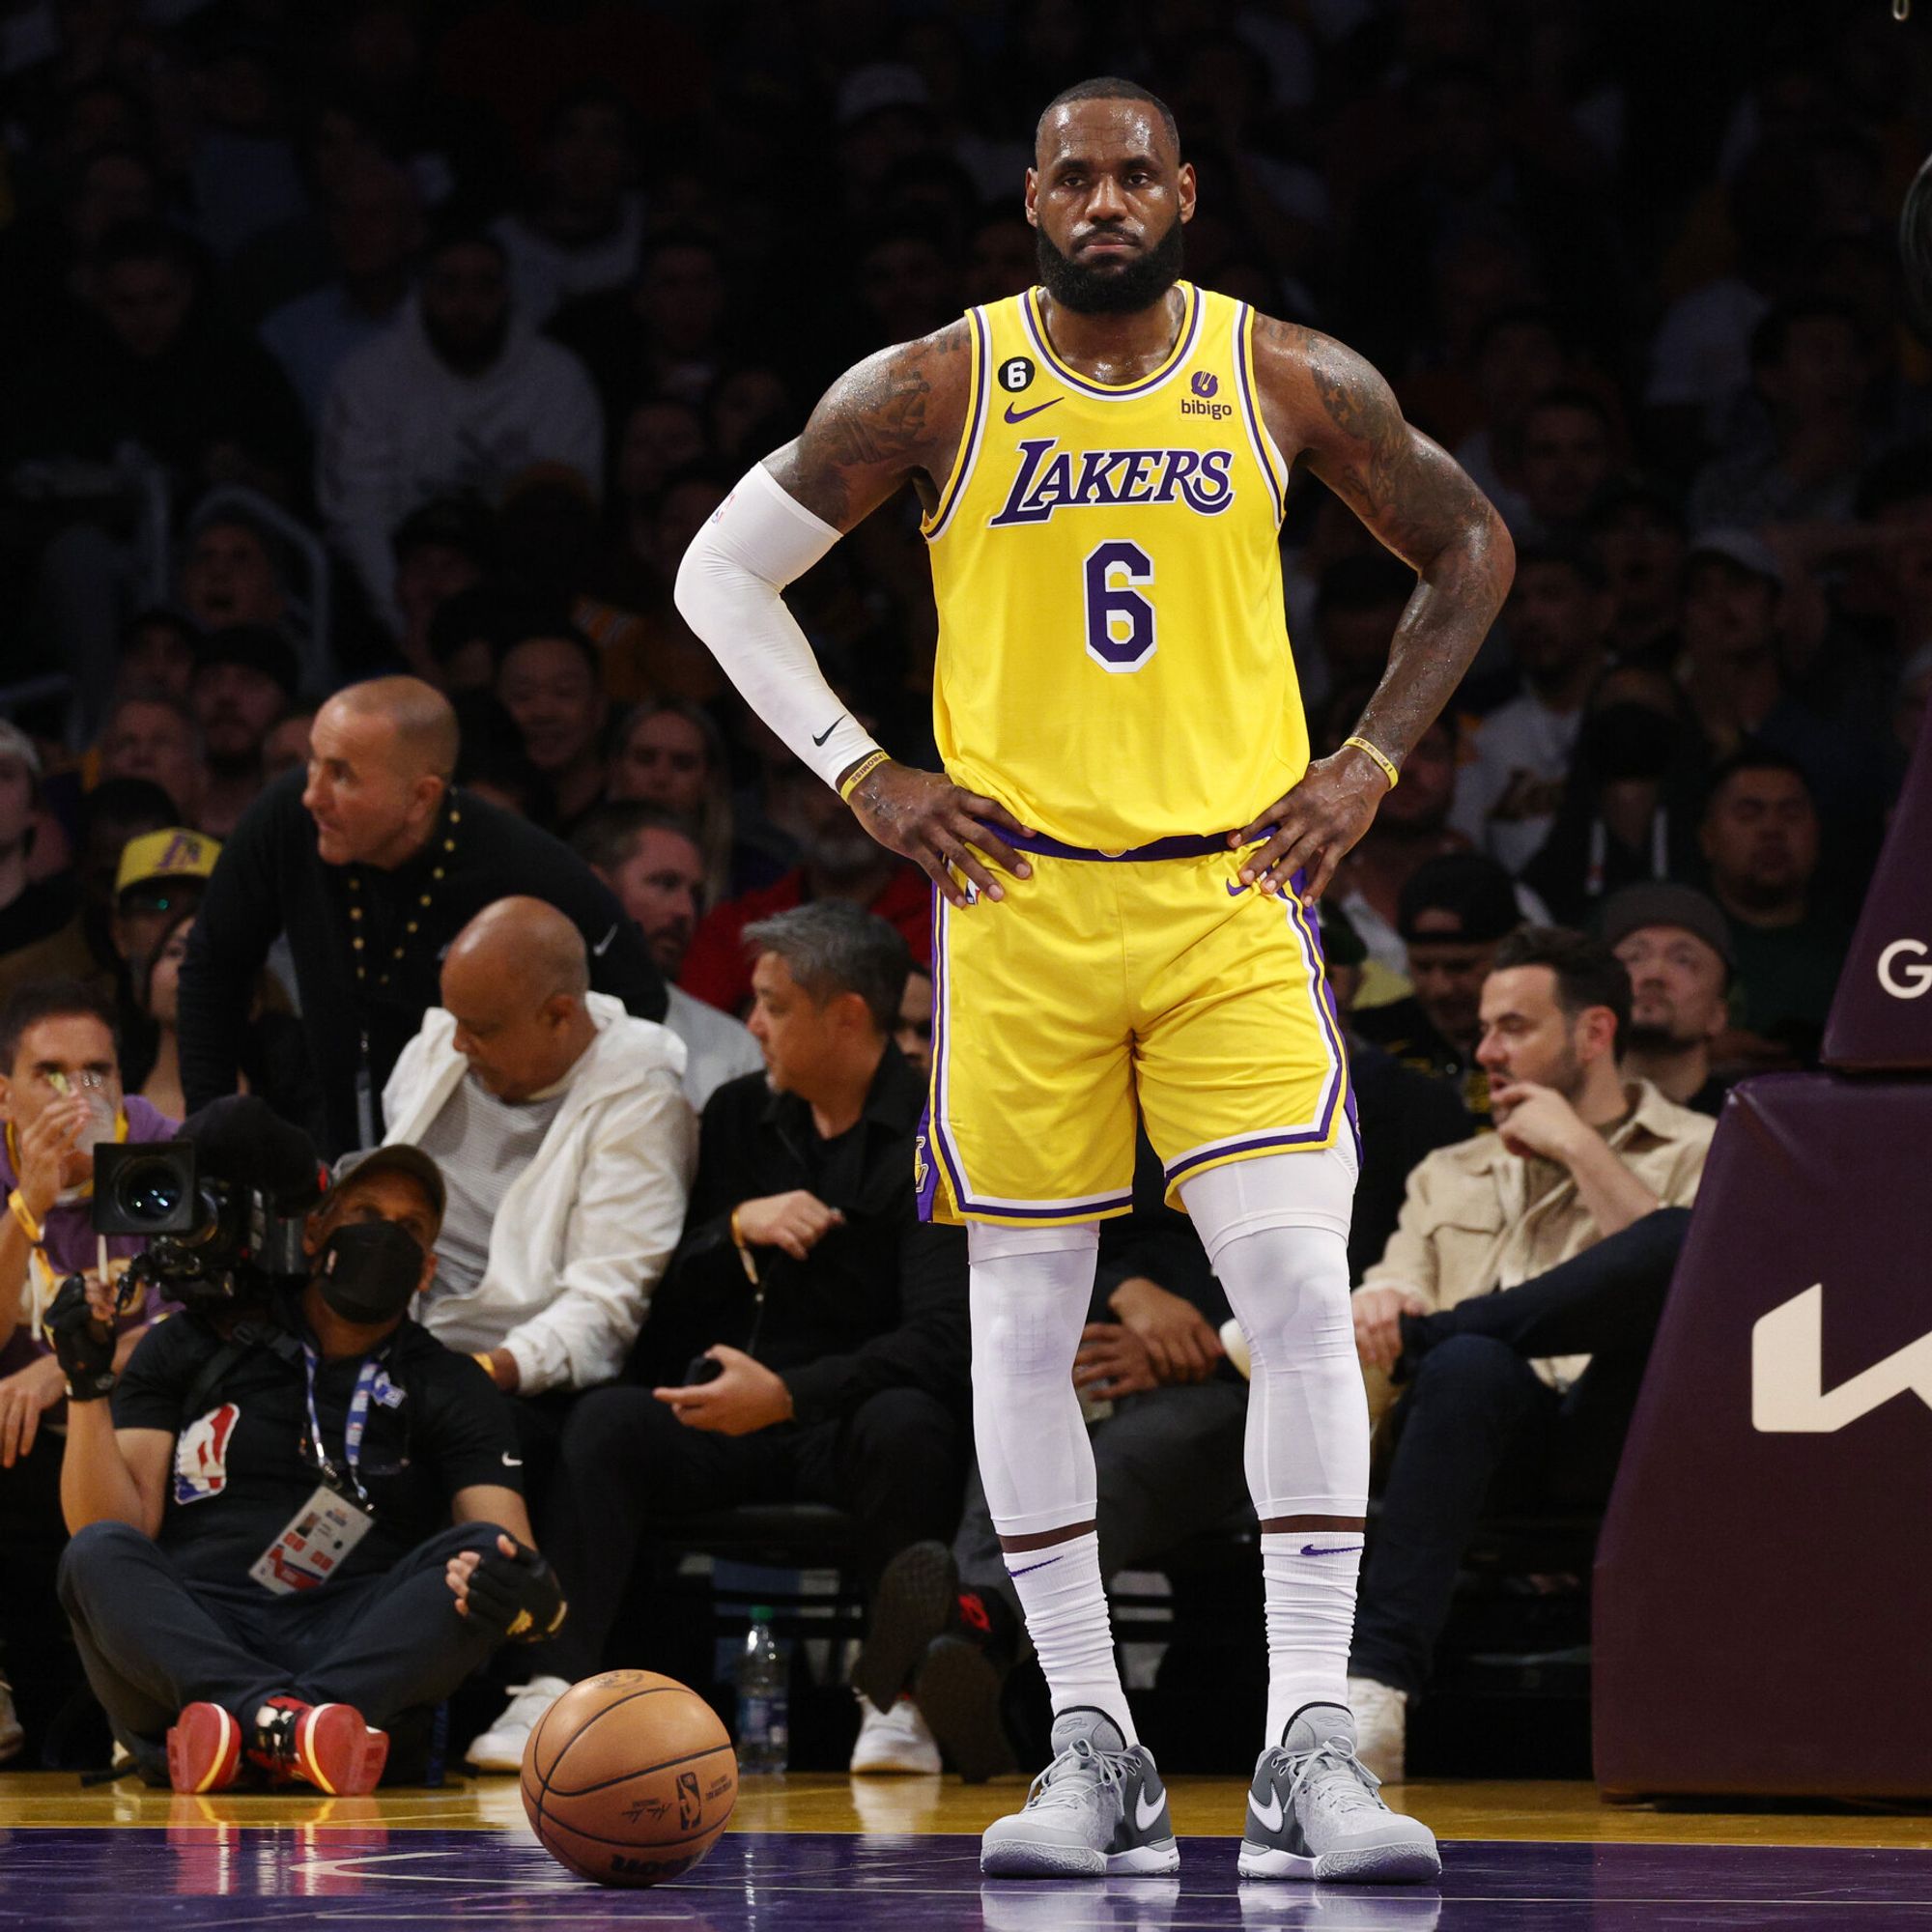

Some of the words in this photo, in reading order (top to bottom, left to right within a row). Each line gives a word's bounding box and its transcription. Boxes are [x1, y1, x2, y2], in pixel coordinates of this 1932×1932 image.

[1008, 360, 1026, 388] 6
[1180, 399, 1233, 420] bibigo
[986, 437, 1236, 529] LAKERS
[1083, 538, 1157, 673] 6
[851, 753, 884, 783] PROMISE
[1877, 938, 1932, 1000] G
